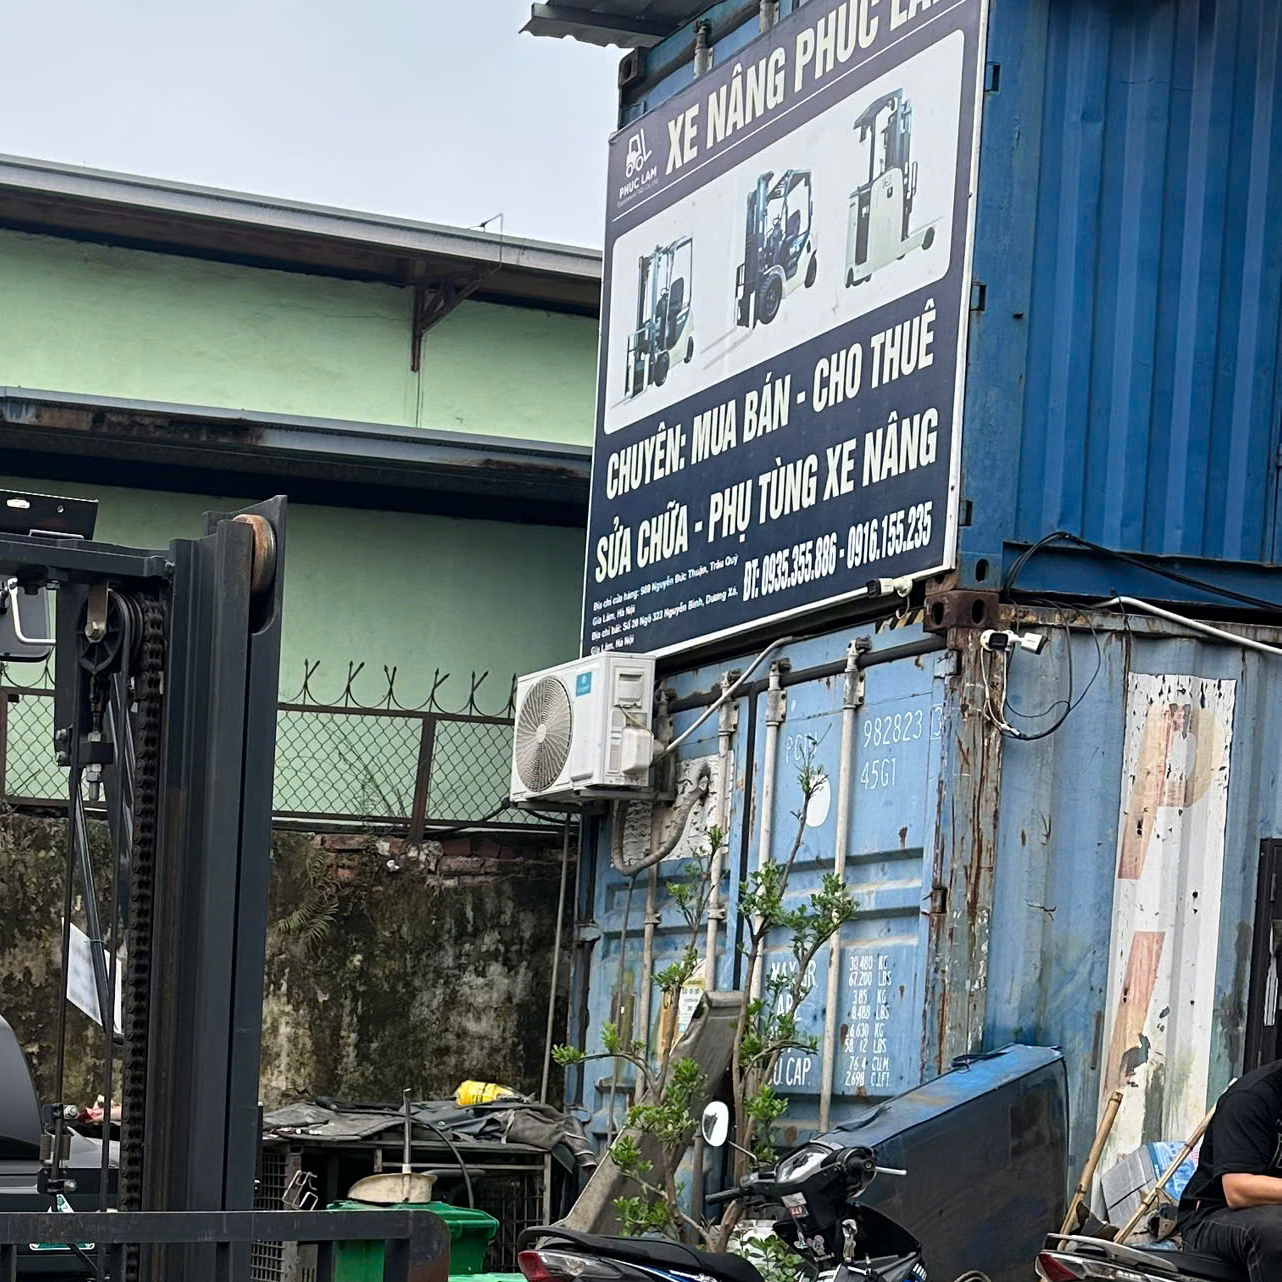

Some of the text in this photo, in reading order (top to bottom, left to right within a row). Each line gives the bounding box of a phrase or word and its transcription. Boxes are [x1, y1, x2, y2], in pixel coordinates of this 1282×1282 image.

[666, 104, 700, 175] XE
[706, 47, 786, 149] NÂNG
[607, 422, 686, 499] CHUYÊN:
[691, 399, 737, 465] MUA
[743, 371, 791, 443] BÁN
[812, 342, 863, 413] CHO
[870, 298, 936, 389] THUÊ
[595, 516, 631, 583] SỬA
[637, 502, 688, 568] CHỮA
[708, 480, 753, 543] PHỤ
[758, 453, 819, 524] TÙNG
[823, 438, 857, 501] XE
[862, 408, 938, 489] NÂNG
[761, 532, 837, 597] 0935.355.886
[847, 501, 932, 569] 0916.155.235
[860, 758, 897, 790] 45G1
[863, 709, 923, 748] 982823
